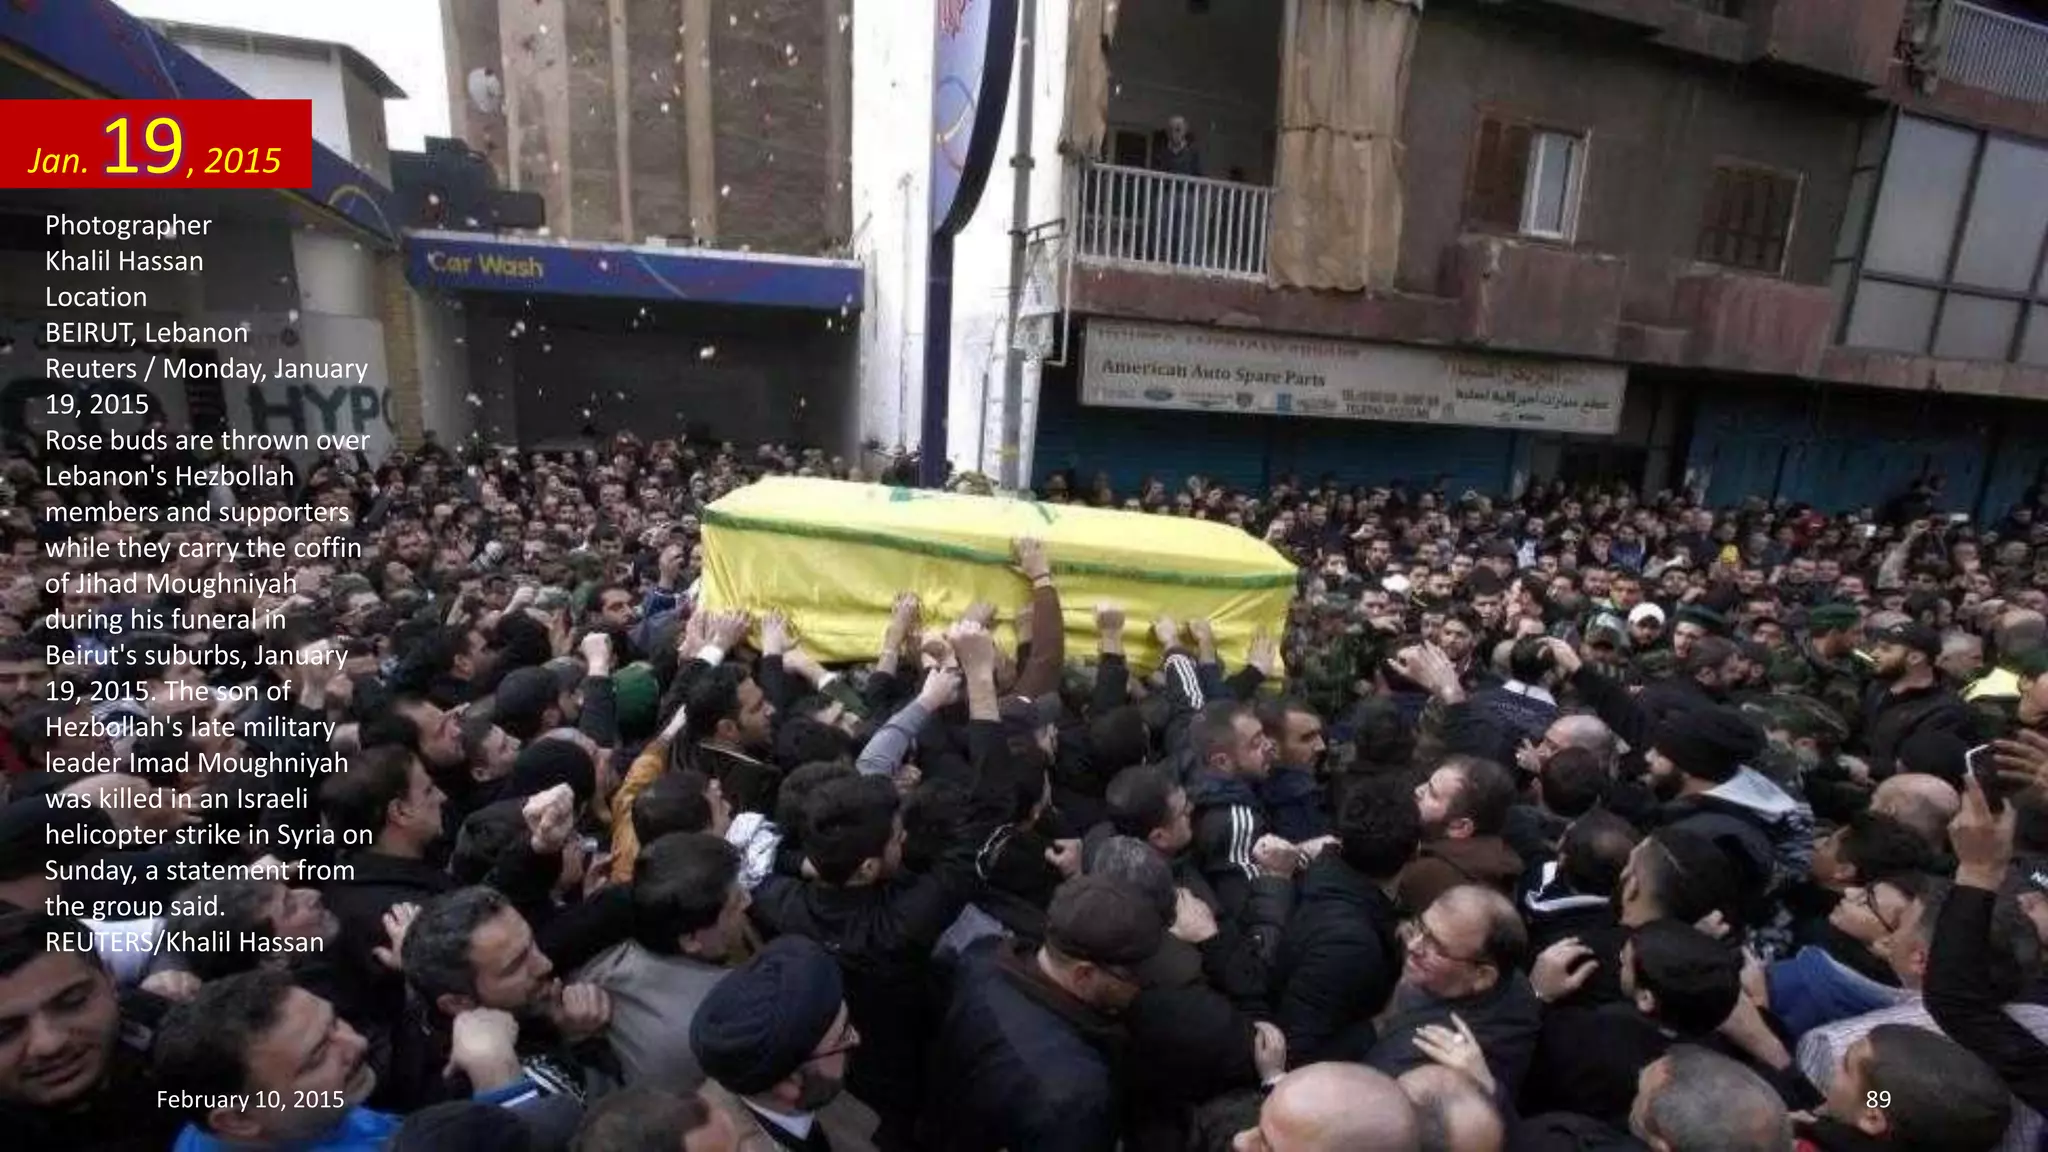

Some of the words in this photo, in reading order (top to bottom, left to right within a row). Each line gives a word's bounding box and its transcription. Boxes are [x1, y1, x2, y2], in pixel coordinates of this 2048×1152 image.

[427, 250, 472, 274] Car
[478, 252, 544, 278] Wash
[247, 384, 398, 437] HYP
